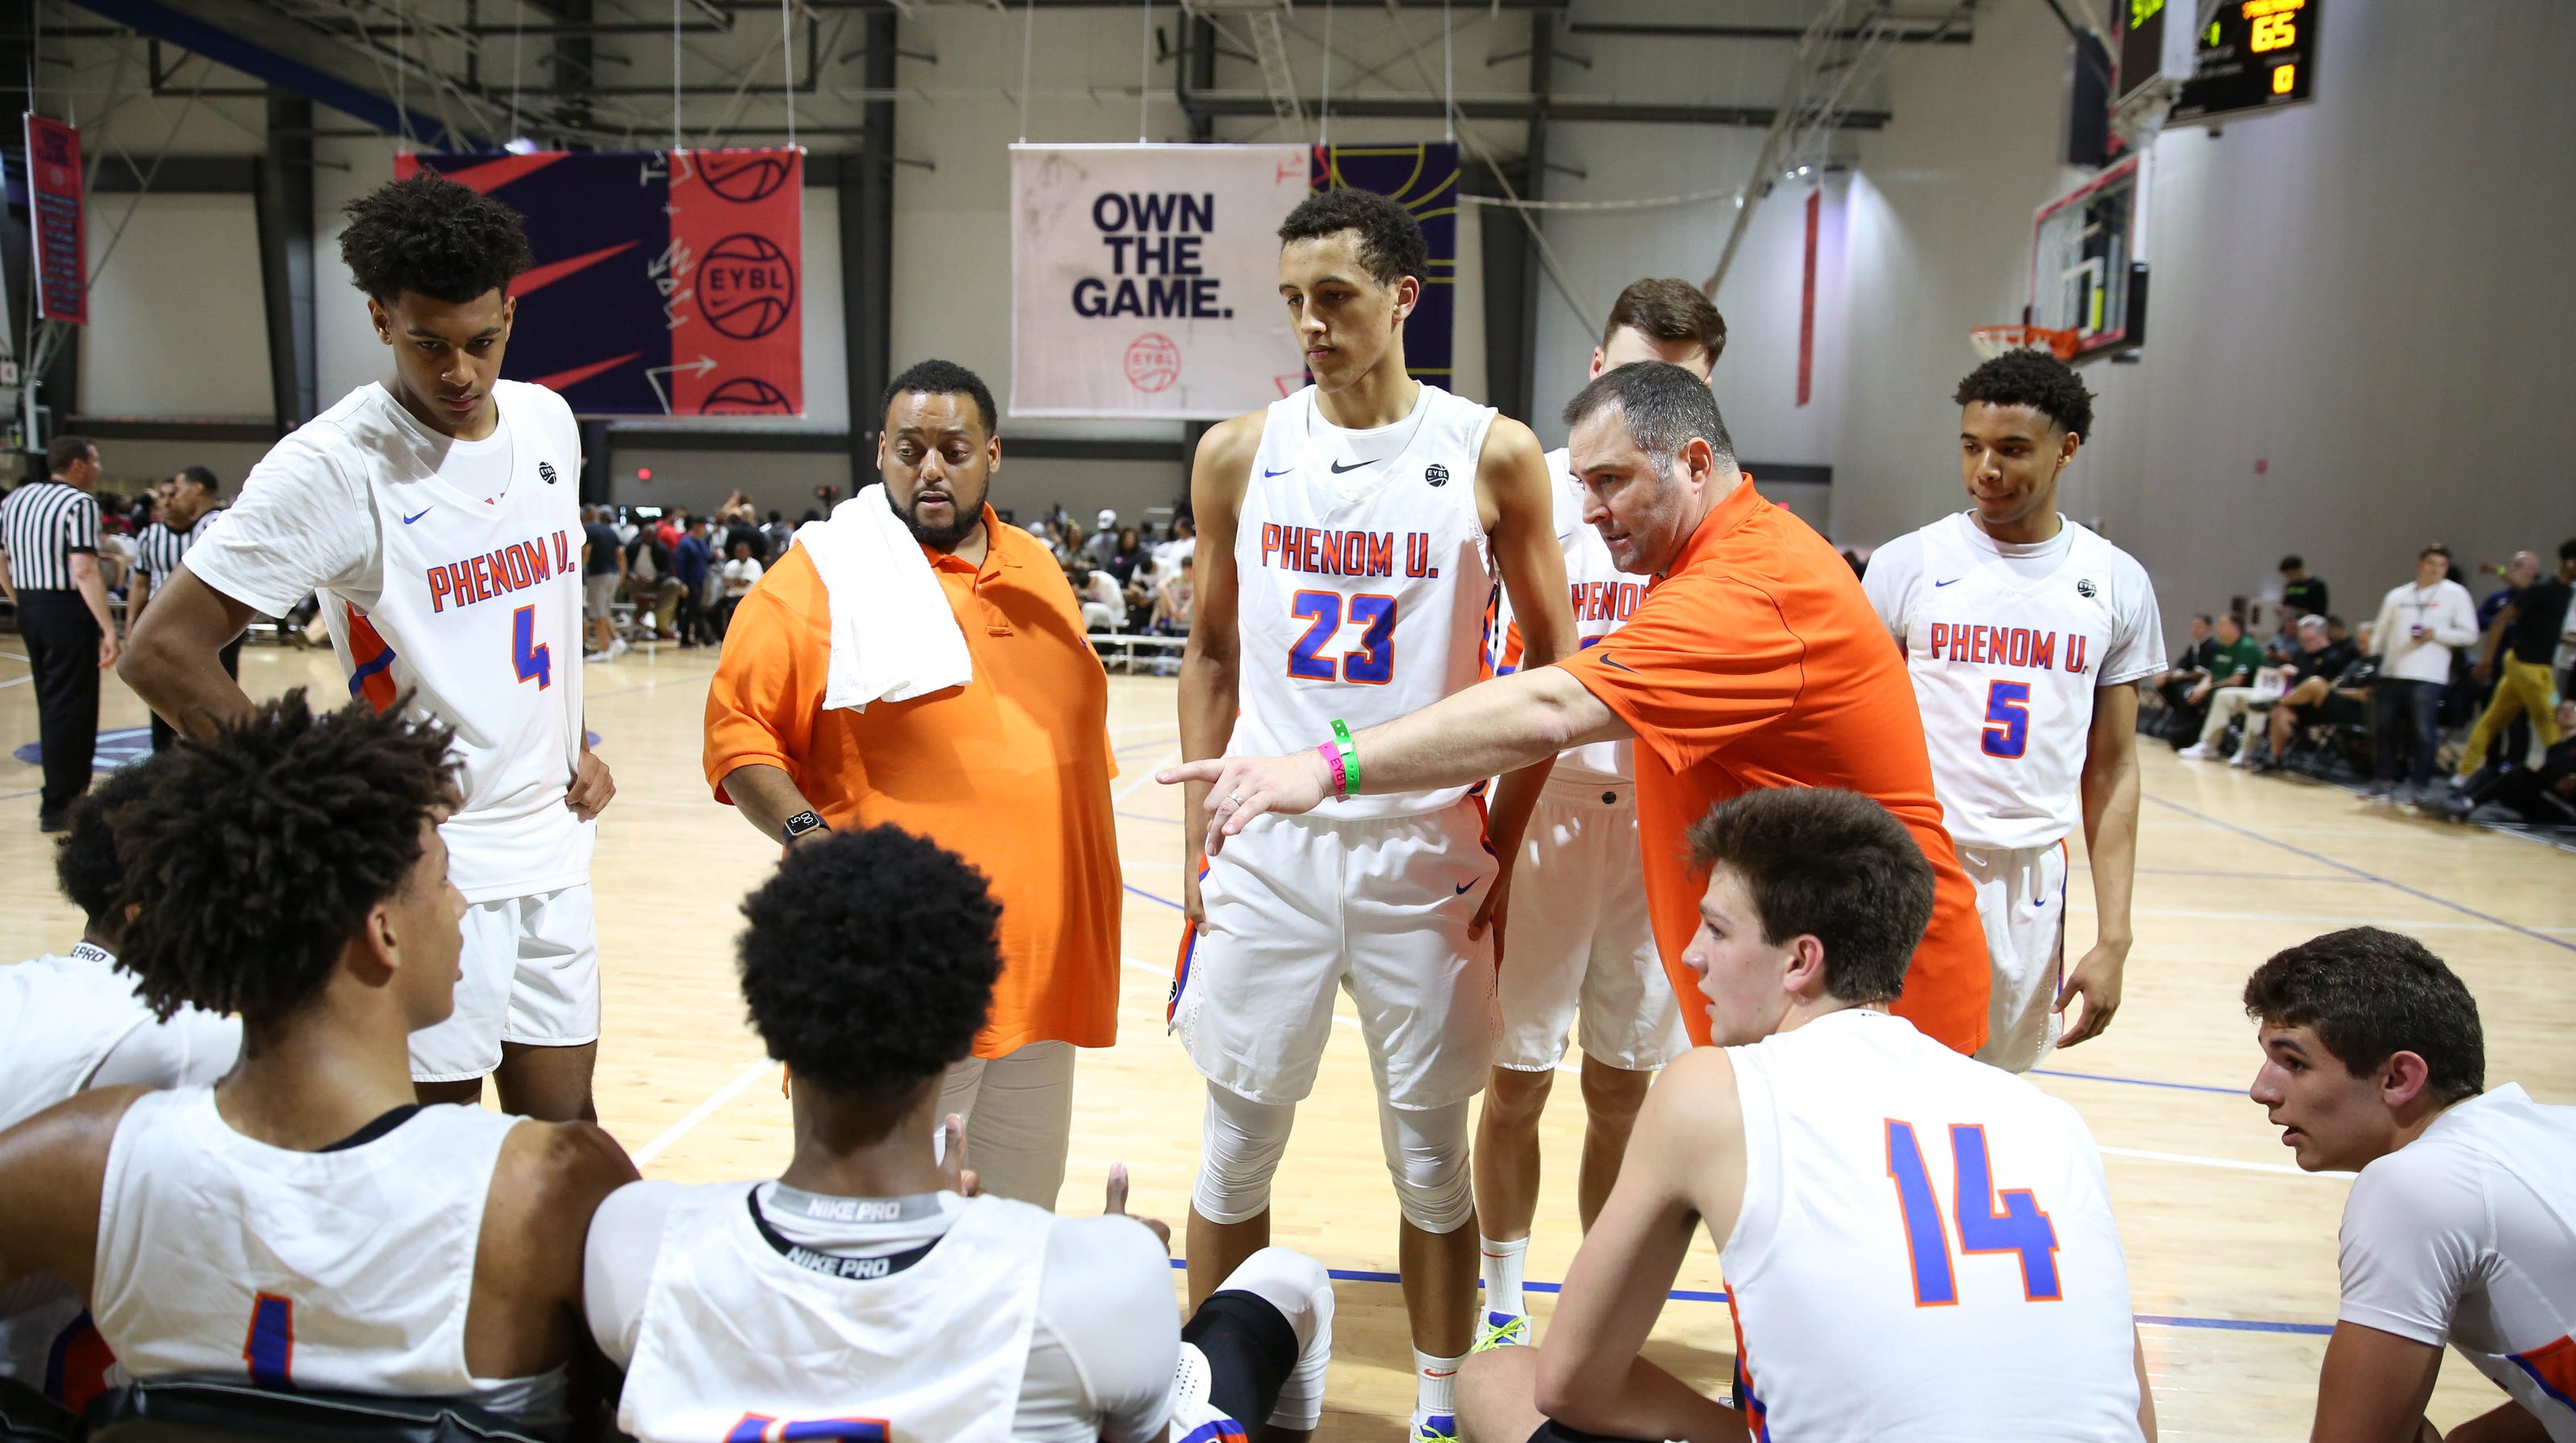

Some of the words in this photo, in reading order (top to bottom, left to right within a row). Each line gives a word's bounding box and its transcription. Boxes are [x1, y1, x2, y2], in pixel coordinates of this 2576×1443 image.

[2250, 10, 2296, 53] 65
[1092, 192, 1214, 233] OWN
[1103, 236, 1203, 275] THE
[709, 267, 784, 290] EYBL
[1072, 278, 1233, 319] GAME.
[1427, 469, 1447, 478] EYBL
[1261, 522, 1393, 577] PHENOM
[1406, 531, 1439, 579] U.
[427, 536, 551, 614] PHENOM
[551, 530, 575, 575] U.
[1571, 581, 1648, 622] HENO
[511, 604, 551, 692] 4
[1286, 589, 1397, 685] 23
[1931, 622, 2055, 670] PHENOM
[2065, 634, 2088, 674] U.
[1980, 679, 2031, 760] 5
[807, 1198, 856, 1222] NIKE
[856, 1201, 902, 1222] PRO
[1883, 1117, 2063, 1308] 14
[786, 1246, 841, 1276] NIKE
[839, 1258, 890, 1279] PRO
